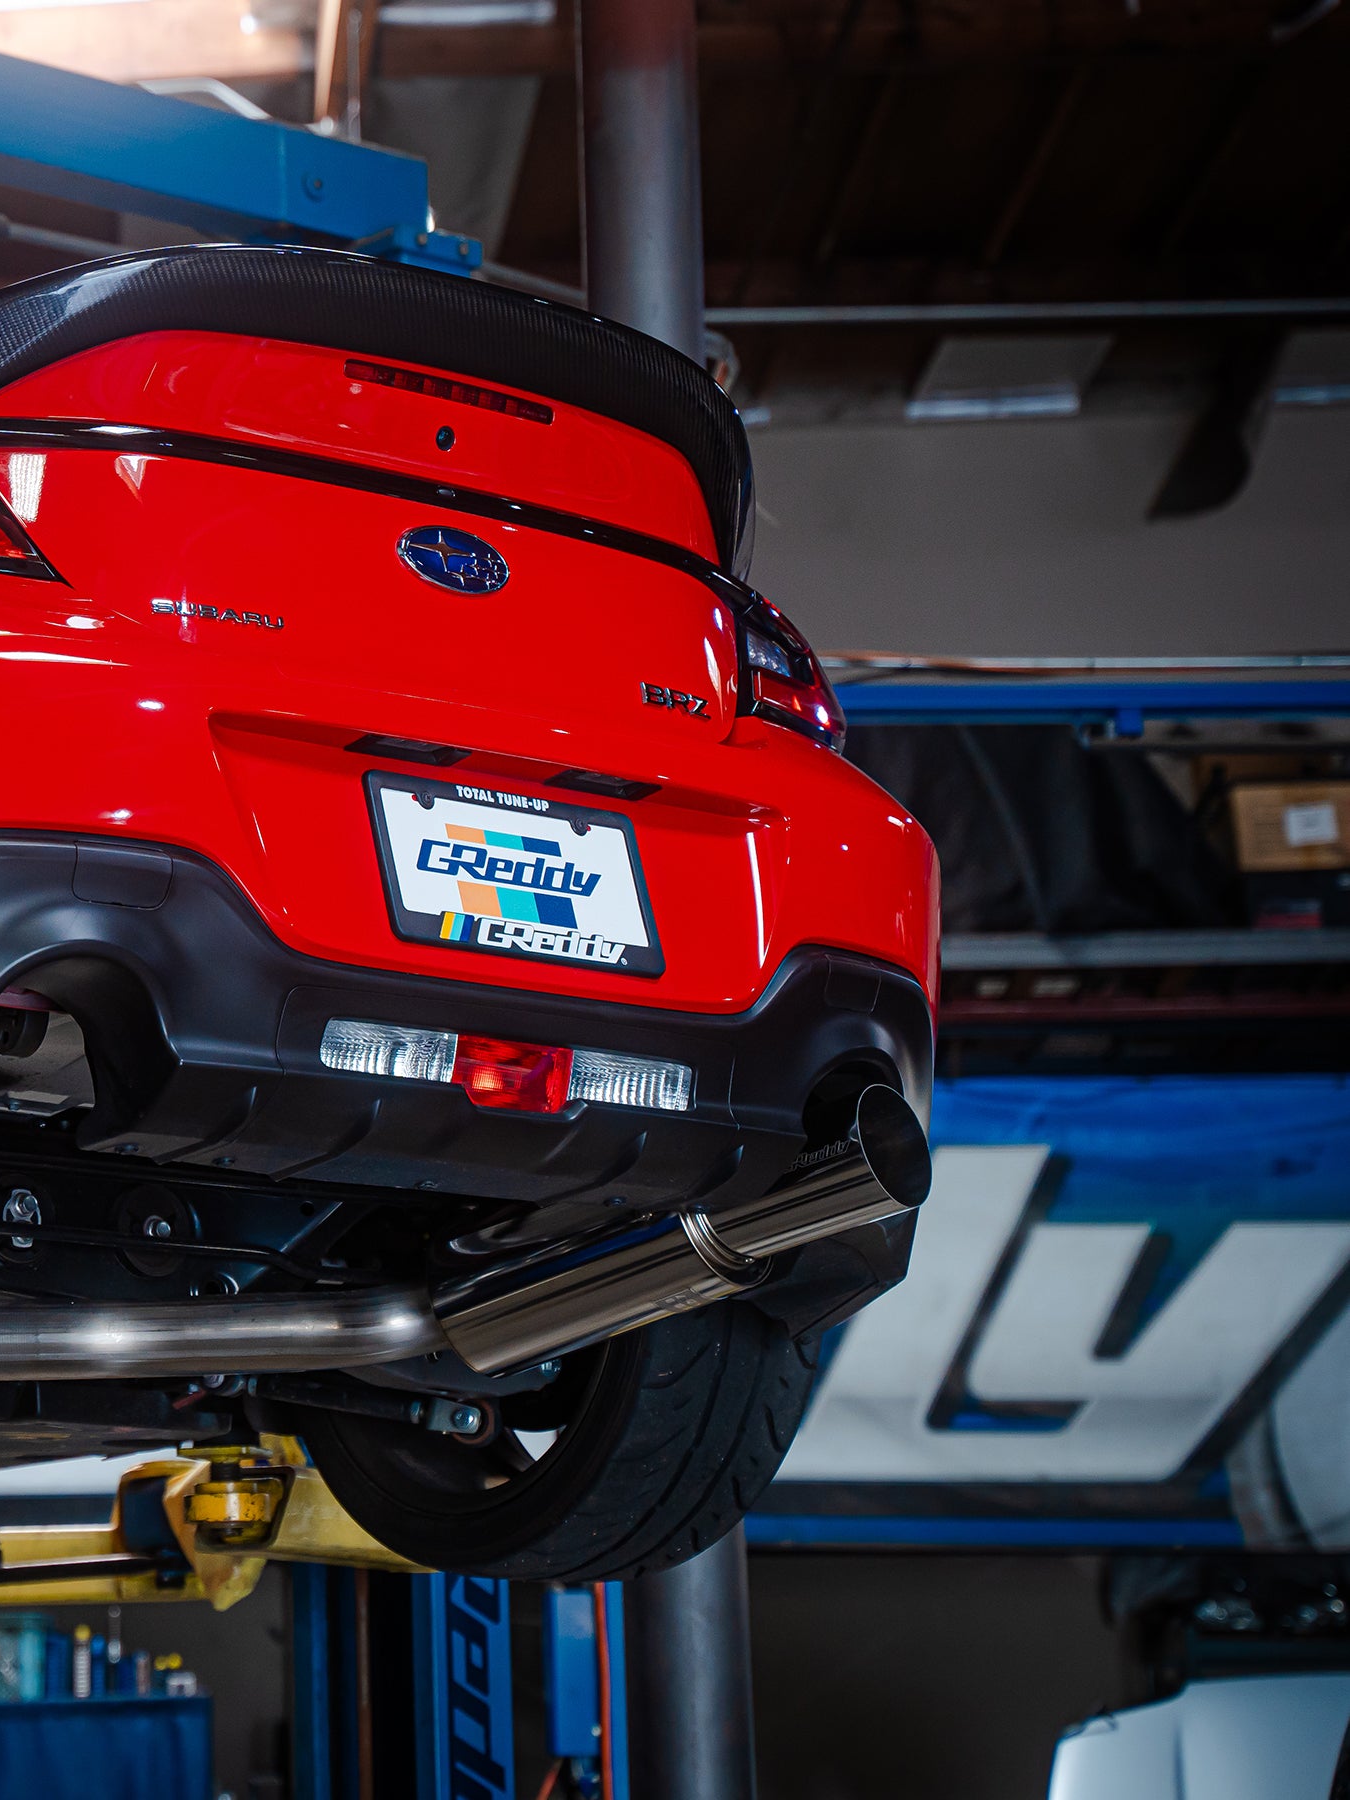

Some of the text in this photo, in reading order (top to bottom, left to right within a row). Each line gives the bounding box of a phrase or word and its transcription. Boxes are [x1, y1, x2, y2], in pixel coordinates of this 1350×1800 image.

[150, 597, 285, 630] SUBARU
[639, 681, 712, 720] BRZ
[455, 784, 550, 812] TOTAL TUNE-UP
[415, 838, 603, 897] GReddy
[476, 917, 628, 965] GReddy
[784, 1138, 852, 1173] Reddy
